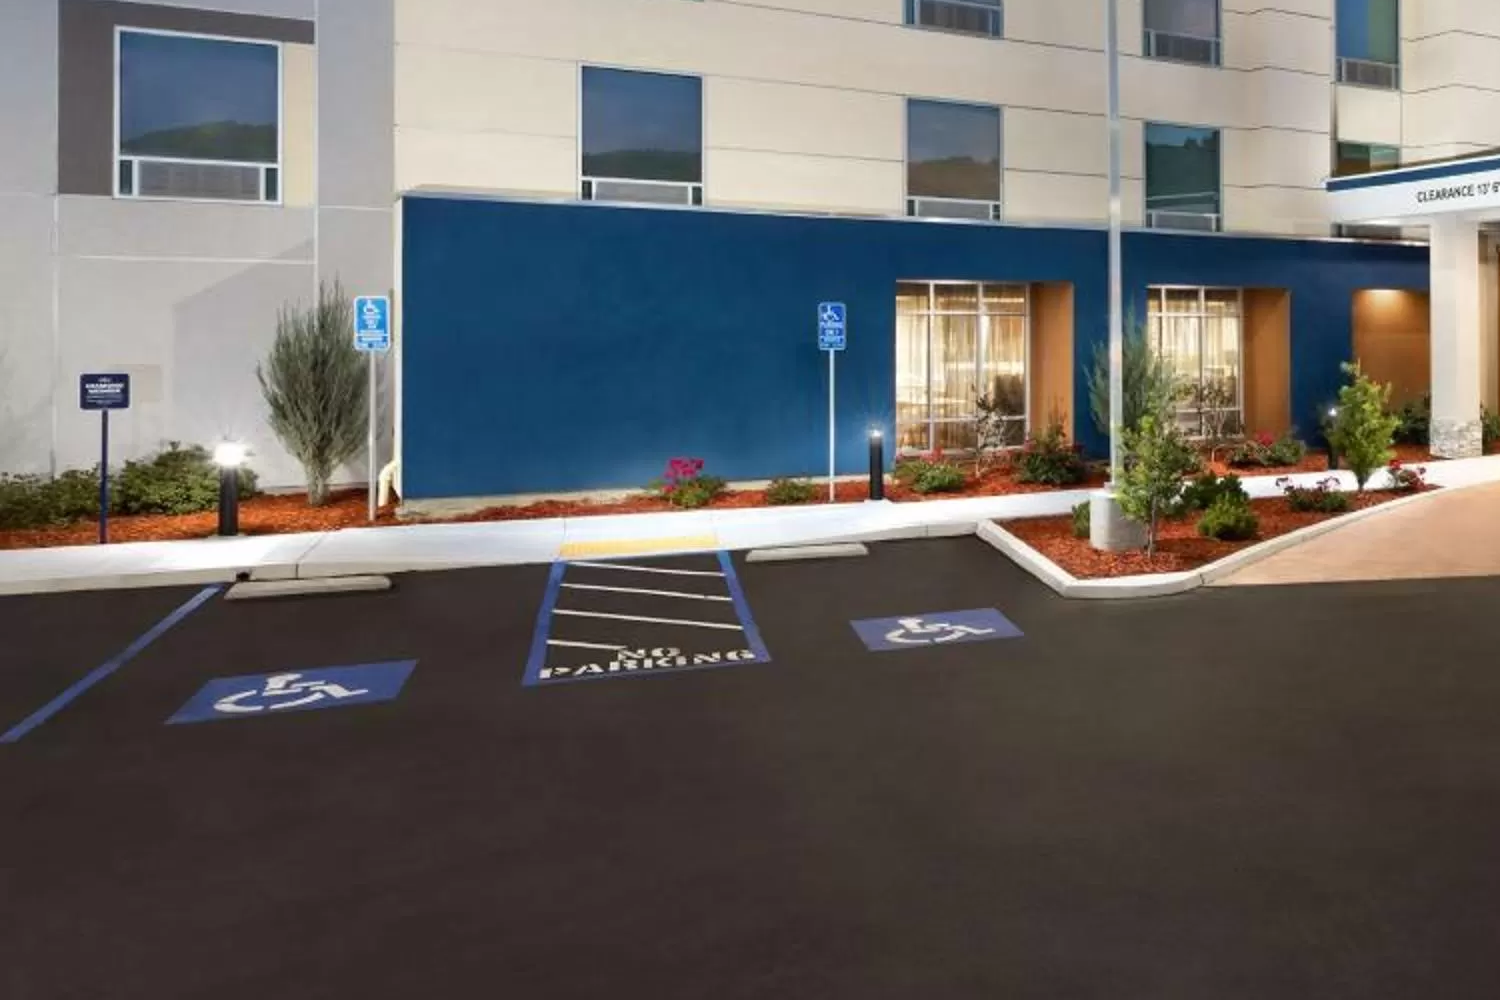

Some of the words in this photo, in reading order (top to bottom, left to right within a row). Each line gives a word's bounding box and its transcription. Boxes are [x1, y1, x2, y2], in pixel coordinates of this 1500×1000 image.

[1416, 184, 1475, 203] CLEARANCE
[617, 647, 681, 660] NO
[539, 649, 756, 680] PARKING
